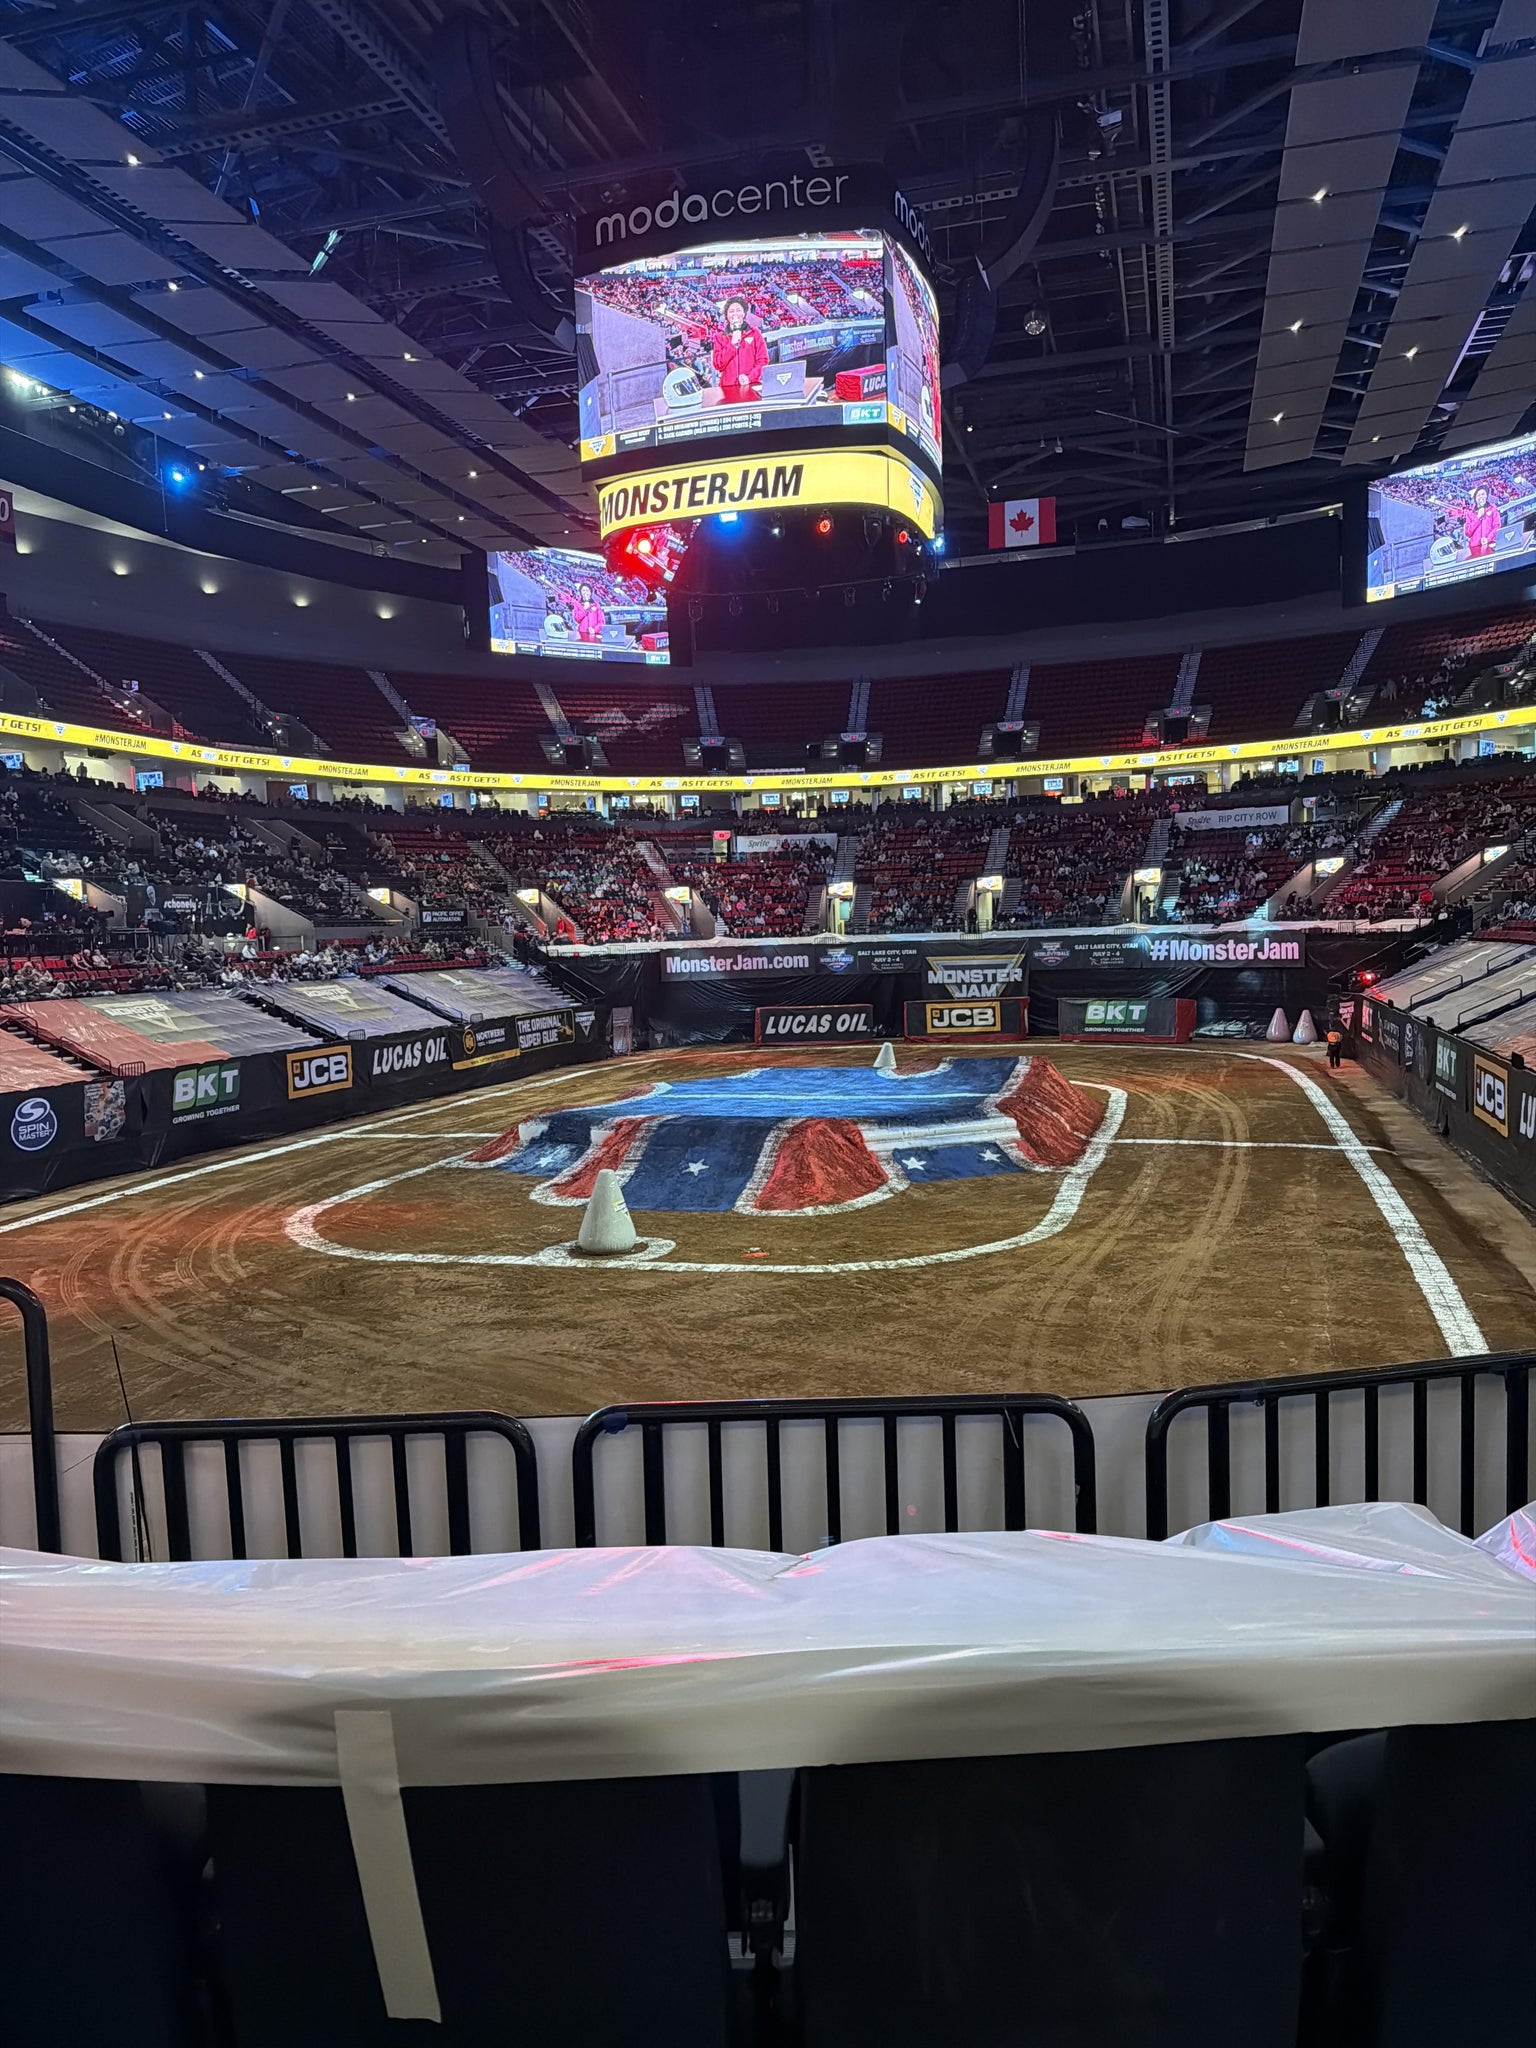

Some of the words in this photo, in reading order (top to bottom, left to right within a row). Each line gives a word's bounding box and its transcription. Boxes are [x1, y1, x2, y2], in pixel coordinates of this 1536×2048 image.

[601, 464, 804, 530] MONSTERJAM
[10, 719, 41, 733] GETS!
[1386, 730, 1400, 738] AS
[1424, 726, 1439, 734] AS
[1453, 719, 1482, 730] GETS!
[95, 733, 147, 750] #MONSTERJAM
[1271, 738, 1330, 752] #MONSTERJAM
[191, 749, 202, 758] AS
[218, 754, 228, 762] AS
[230, 755, 241, 763] IT
[242, 756, 271, 767] GETS!
[1124, 757, 1138, 766] AS
[1159, 754, 1172, 762] AS
[1186, 750, 1216, 760] GETS!
[318, 764, 369, 777] #MONSTERJAM
[913, 771, 925, 779] AS
[938, 769, 966, 778] GETS!
[1016, 762, 1071, 773] #MONSTERJAM
[418, 772, 431, 780] AS
[473, 775, 500, 784] GETS!
[550, 779, 601, 788] #MONSTERJAM
[780, 777, 833, 786] #MONSTERJAM
[1218, 815, 1232, 823] RIP
[1234, 813, 1254, 822] CITY
[1256, 811, 1278, 821] ROW
[747, 839, 770, 848] Sprite
[1150, 937, 1299, 961] #MonsterJam
[666, 953, 809, 974] MonsterJam.com
[927, 968, 1023, 985] MONSTER
[953, 982, 996, 998] JAM
[104, 1003, 171, 1017] MONSTER
[932, 1008, 995, 1027] JCB
[1086, 1004, 1147, 1021] BKT
[517, 1019, 532, 1034] THE
[531, 1014, 561, 1031] ORIGINAL
[765, 1014, 833, 1035] LUCAS
[475, 1028, 506, 1040] NORTHERN
[519, 1032, 541, 1049] SUPER
[542, 1029, 559, 1043] GLUE
[372, 1043, 422, 1076] LUCAS
[1436, 1045, 1457, 1077] BKT
[294, 1054, 348, 1088] JCB
[174, 1069, 239, 1103] BKT
[1476, 1070, 1505, 1120] JCB
[172, 1111, 205, 1125] GROWING
[206, 1104, 241, 1118] TOGETHER
[18, 1122, 50, 1135] SPIN
[18, 1130, 51, 1141] MASTER
